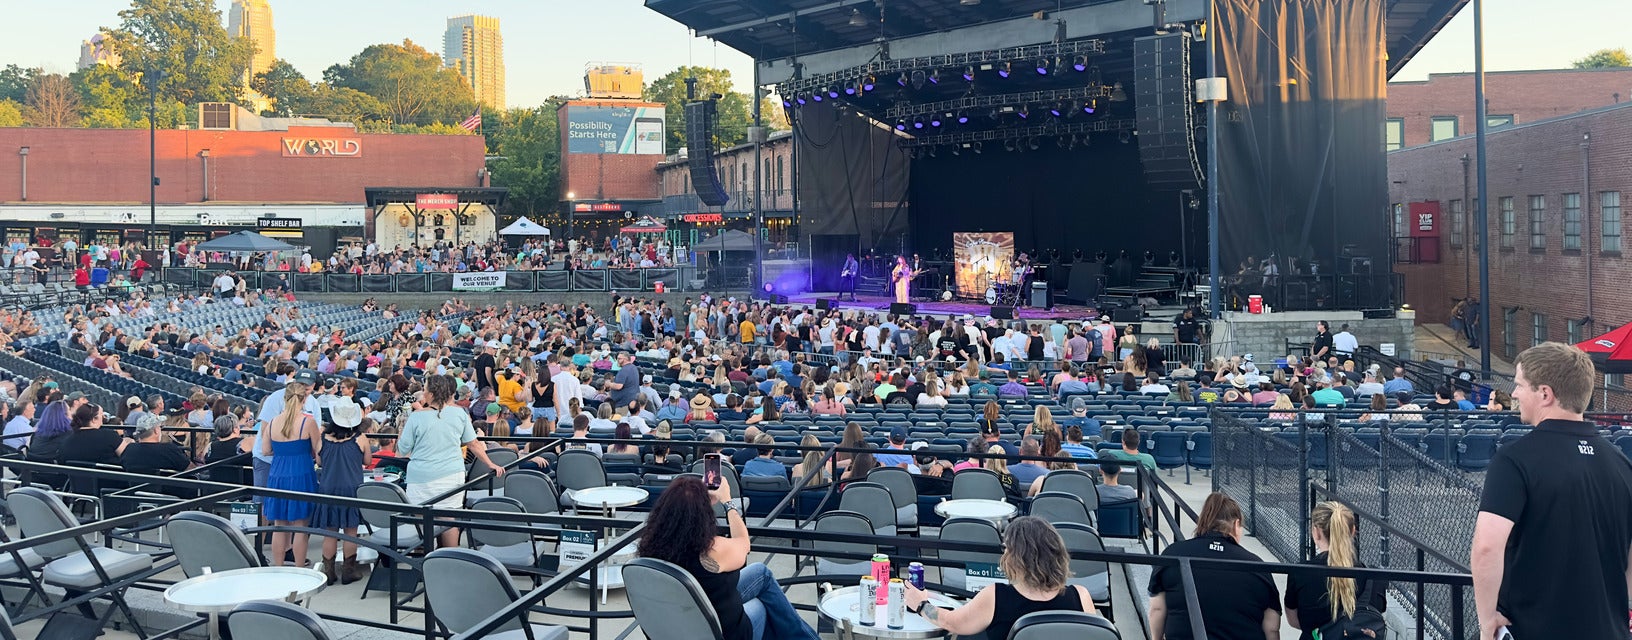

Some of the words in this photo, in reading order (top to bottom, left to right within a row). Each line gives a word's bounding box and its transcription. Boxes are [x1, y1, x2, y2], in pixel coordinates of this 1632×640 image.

[569, 121, 613, 131] Possibility
[569, 130, 595, 139] Starts
[596, 131, 617, 139] Here
[284, 139, 360, 155] WORLD
[683, 214, 722, 222] CONCESSIONS
